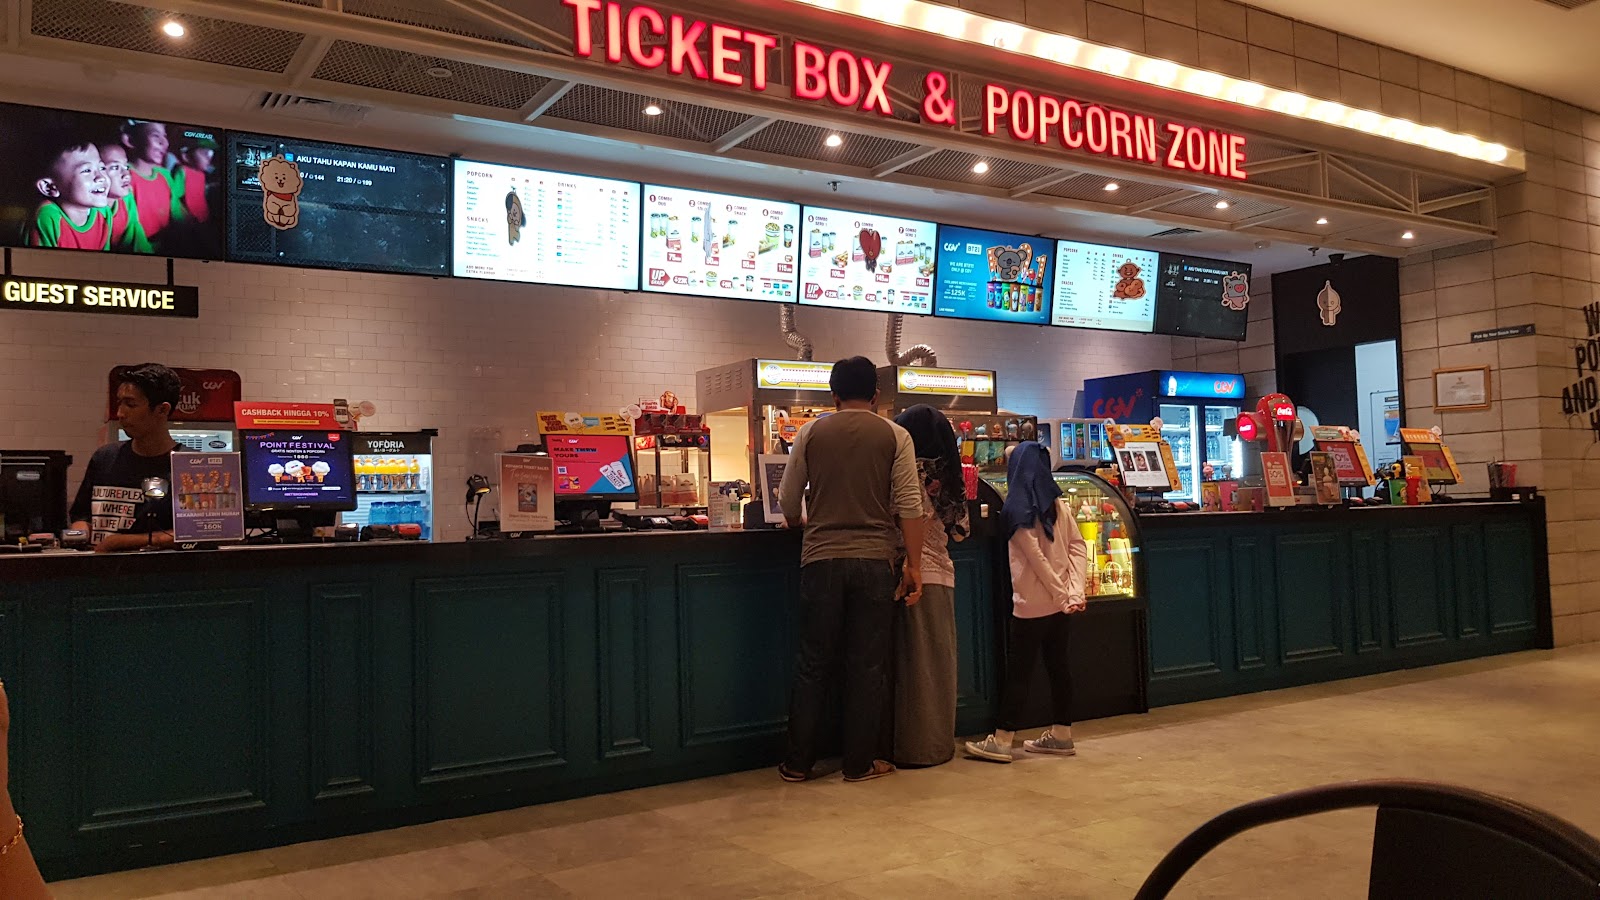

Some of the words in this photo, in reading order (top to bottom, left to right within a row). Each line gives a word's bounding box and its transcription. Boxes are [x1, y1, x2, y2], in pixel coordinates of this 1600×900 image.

[562, 0, 777, 91] TICKET
[792, 41, 893, 116] BOX
[923, 72, 956, 125] &
[984, 84, 1158, 163] POPCORN
[1164, 122, 1248, 180] ZONE
[313, 157, 332, 166] TAHU
[333, 160, 356, 168] KAPAN
[358, 162, 378, 171] KAMU
[379, 165, 396, 173] MATI
[466, 170, 493, 179] POPCORN
[944, 243, 959, 252] CGV
[652, 269, 666, 280] UP
[4, 281, 78, 304] GUEST
[83, 286, 174, 310] SERVICE
[807, 284, 818, 294] UP
[1575, 336, 1600, 378] PO
[202, 380, 226, 389] CGV
[1214, 380, 1235, 394] CGV
[1562, 376, 1598, 415] AND
[1092, 396, 1137, 420] CGV
[102, 503, 134, 515] WHERE
